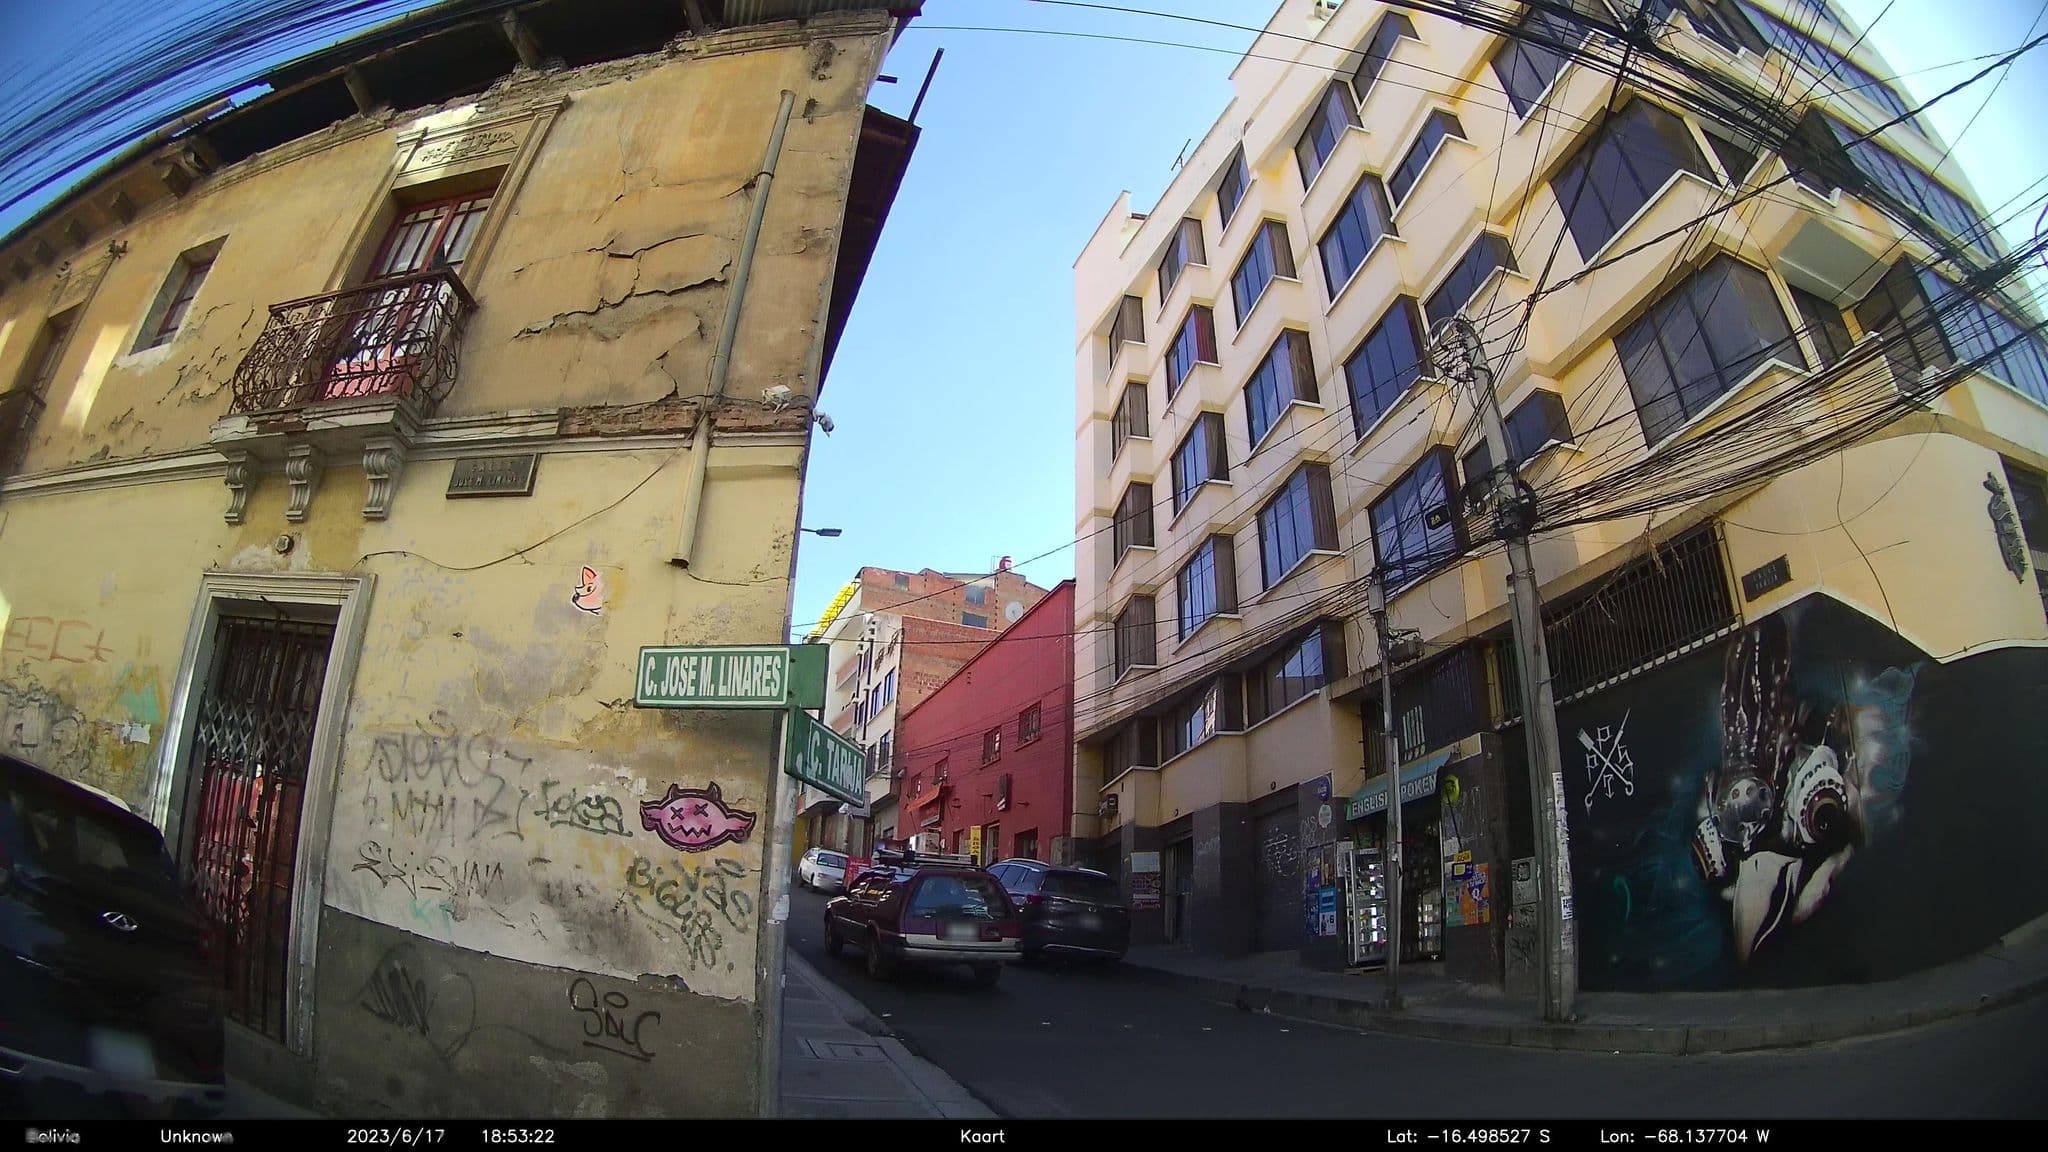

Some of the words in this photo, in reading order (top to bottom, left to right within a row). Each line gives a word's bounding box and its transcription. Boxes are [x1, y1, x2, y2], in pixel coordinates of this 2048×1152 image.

[645, 656, 657, 696] C.
[661, 656, 697, 696] JOSE
[700, 655, 714, 696] M.
[719, 655, 781, 697] LINARES
[826, 737, 863, 795] TARIJA
[1400, 773, 1438, 798] POKEN
